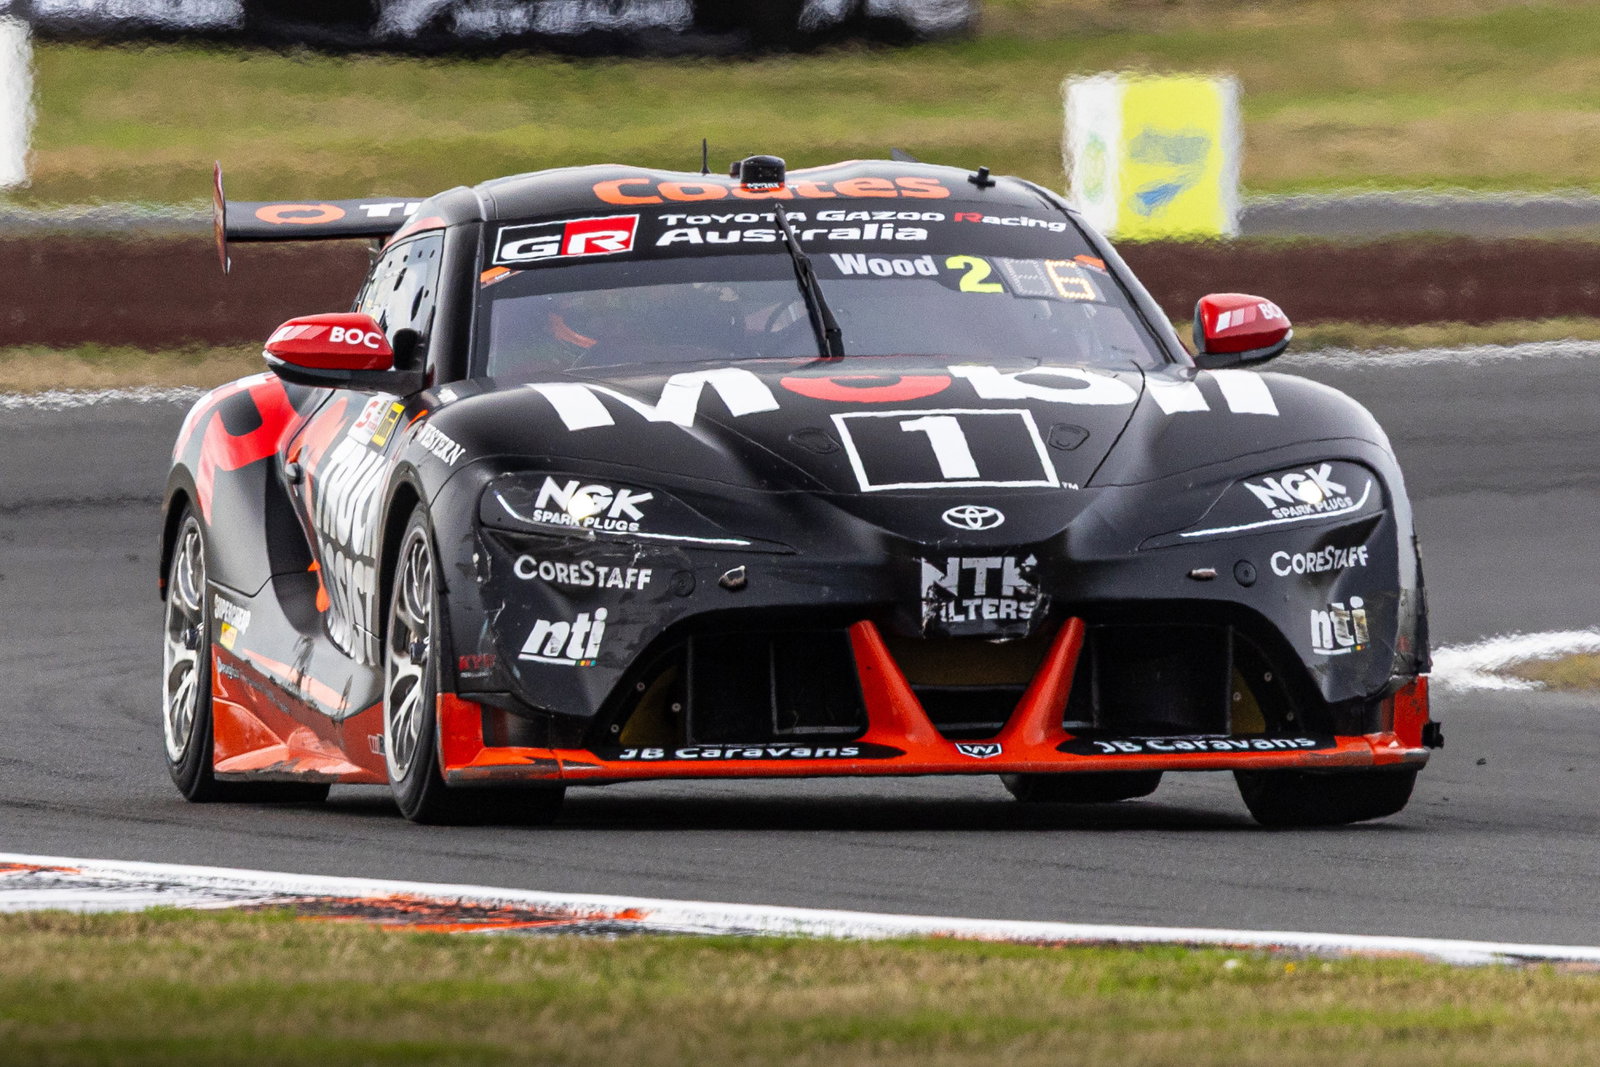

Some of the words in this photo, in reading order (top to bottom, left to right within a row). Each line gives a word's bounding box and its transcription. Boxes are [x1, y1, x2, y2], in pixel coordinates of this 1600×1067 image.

[592, 177, 951, 205] Coates
[655, 223, 929, 247] Australia
[657, 212, 808, 226] TOYOTA
[816, 210, 945, 222] GAZOO
[953, 212, 1067, 233] Racing
[500, 230, 631, 260] GR
[829, 253, 940, 277] Wood
[944, 255, 1004, 293] 2
[1044, 259, 1096, 300] 6
[329, 326, 382, 349] BOC
[900, 415, 981, 480] 1
[534, 476, 654, 522] NGK
[1244, 463, 1347, 509] NGK
[532, 509, 580, 528] SPARK
[583, 516, 640, 532] PLUGS
[1271, 502, 1315, 520] SPARK
[921, 553, 1038, 597] NTK
[520, 607, 608, 659] nti
[619, 748, 665, 759] JB
[674, 746, 860, 759] Caravans
[1093, 740, 1142, 754] JB
[1146, 737, 1316, 751] Caravans
